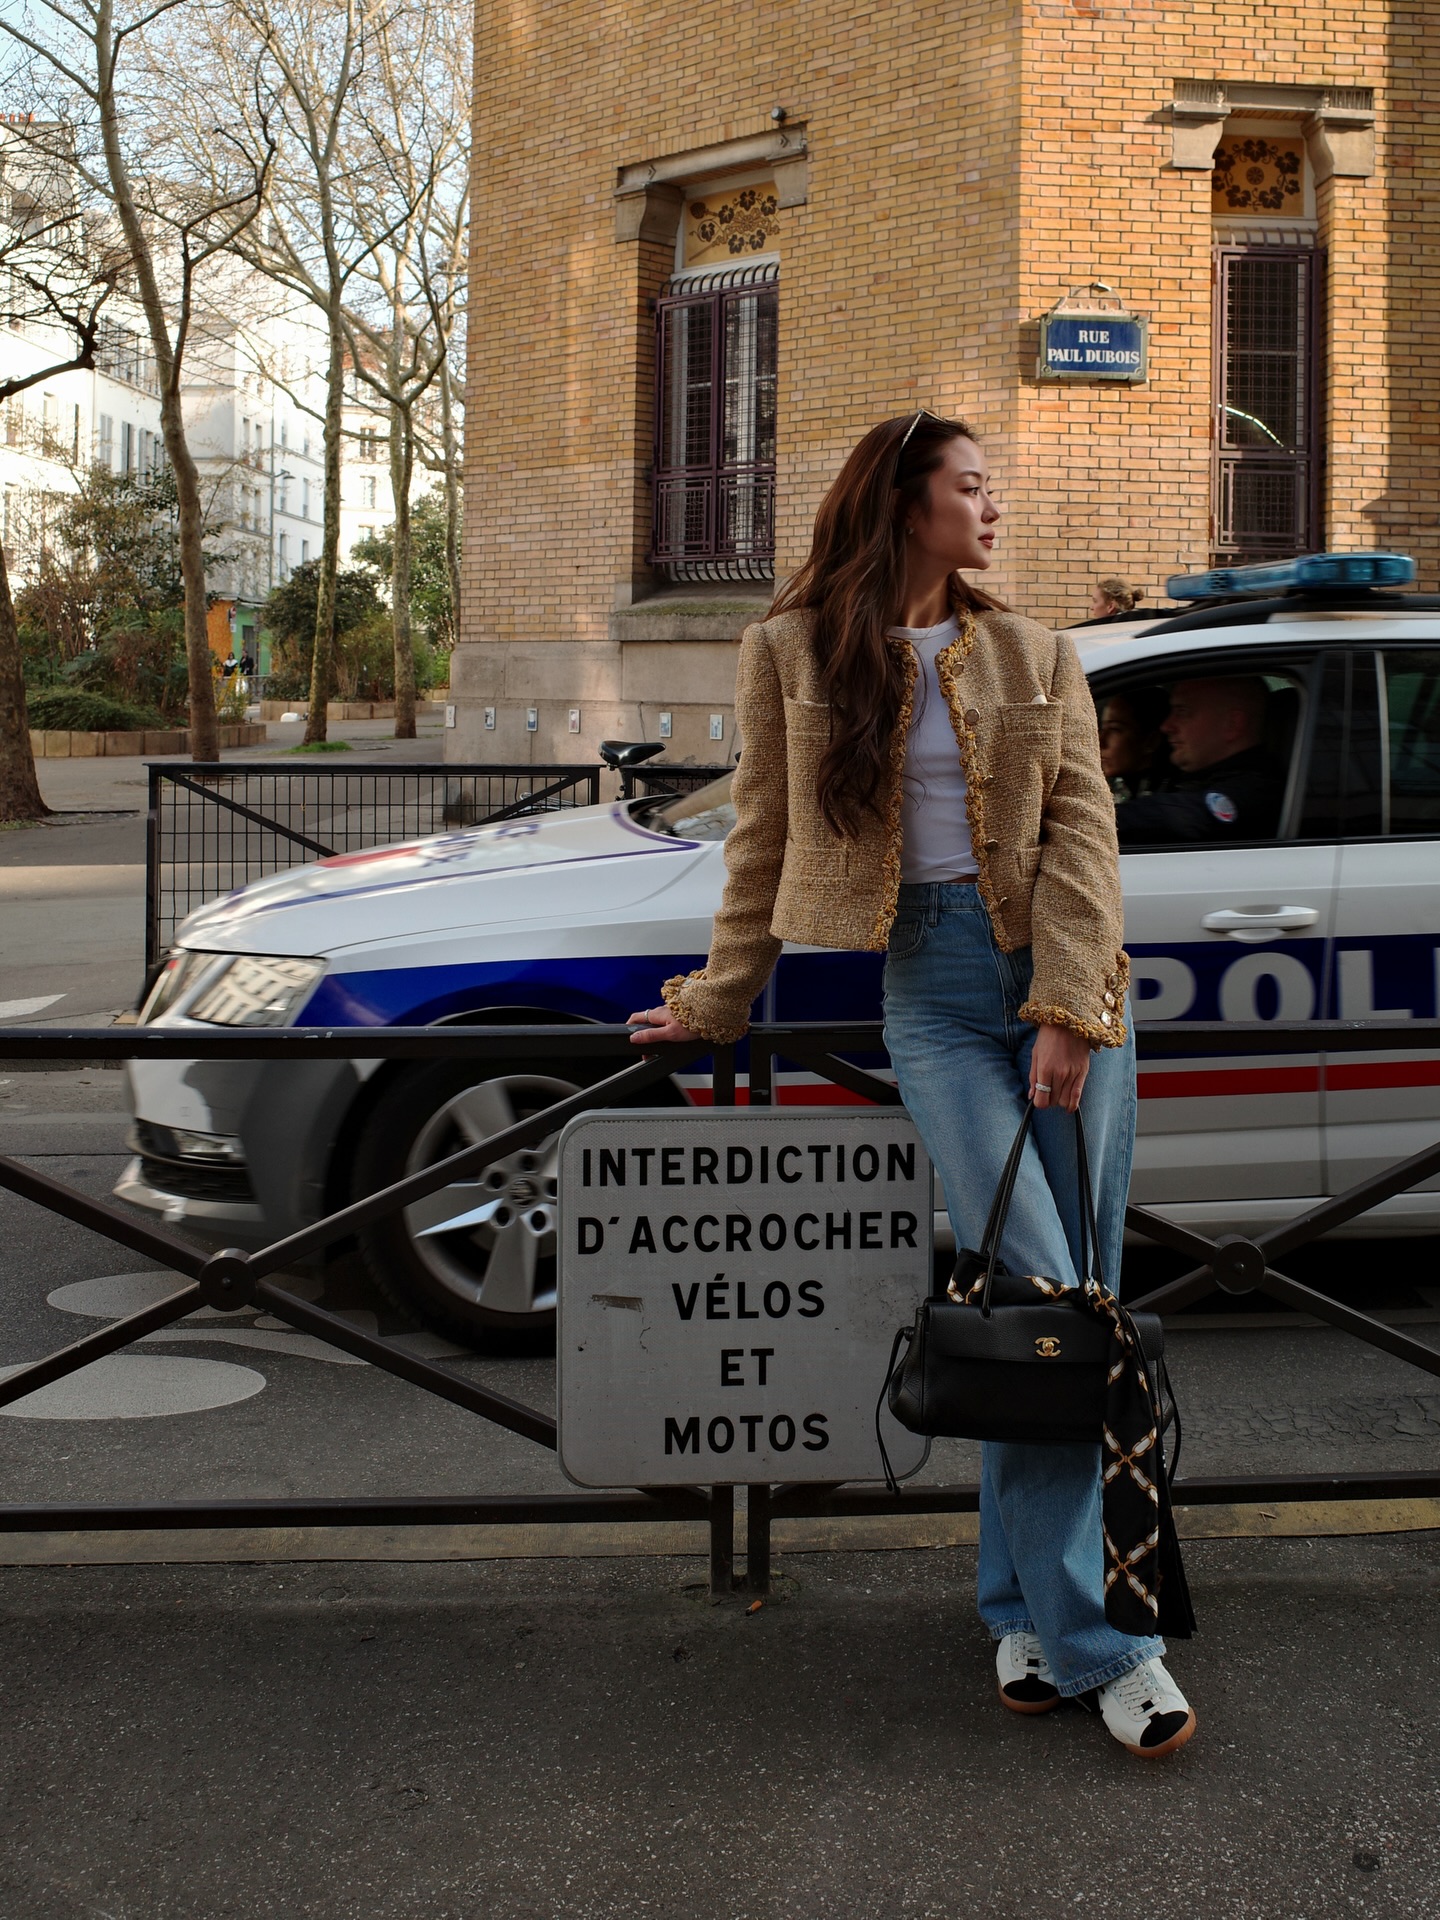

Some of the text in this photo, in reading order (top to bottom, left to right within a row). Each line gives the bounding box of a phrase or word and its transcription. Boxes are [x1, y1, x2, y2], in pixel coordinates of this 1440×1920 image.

[1047, 348, 1140, 364] PAUL DUBOIS
[1078, 330, 1110, 344] RUE
[1131, 947, 1440, 1021] POL
[582, 1142, 916, 1187] INTERDICTION
[577, 1210, 918, 1255] D'ACCROCHER
[671, 1273, 825, 1321] VÉLOS
[720, 1348, 775, 1387] ET
[664, 1413, 830, 1455] MOTOS
